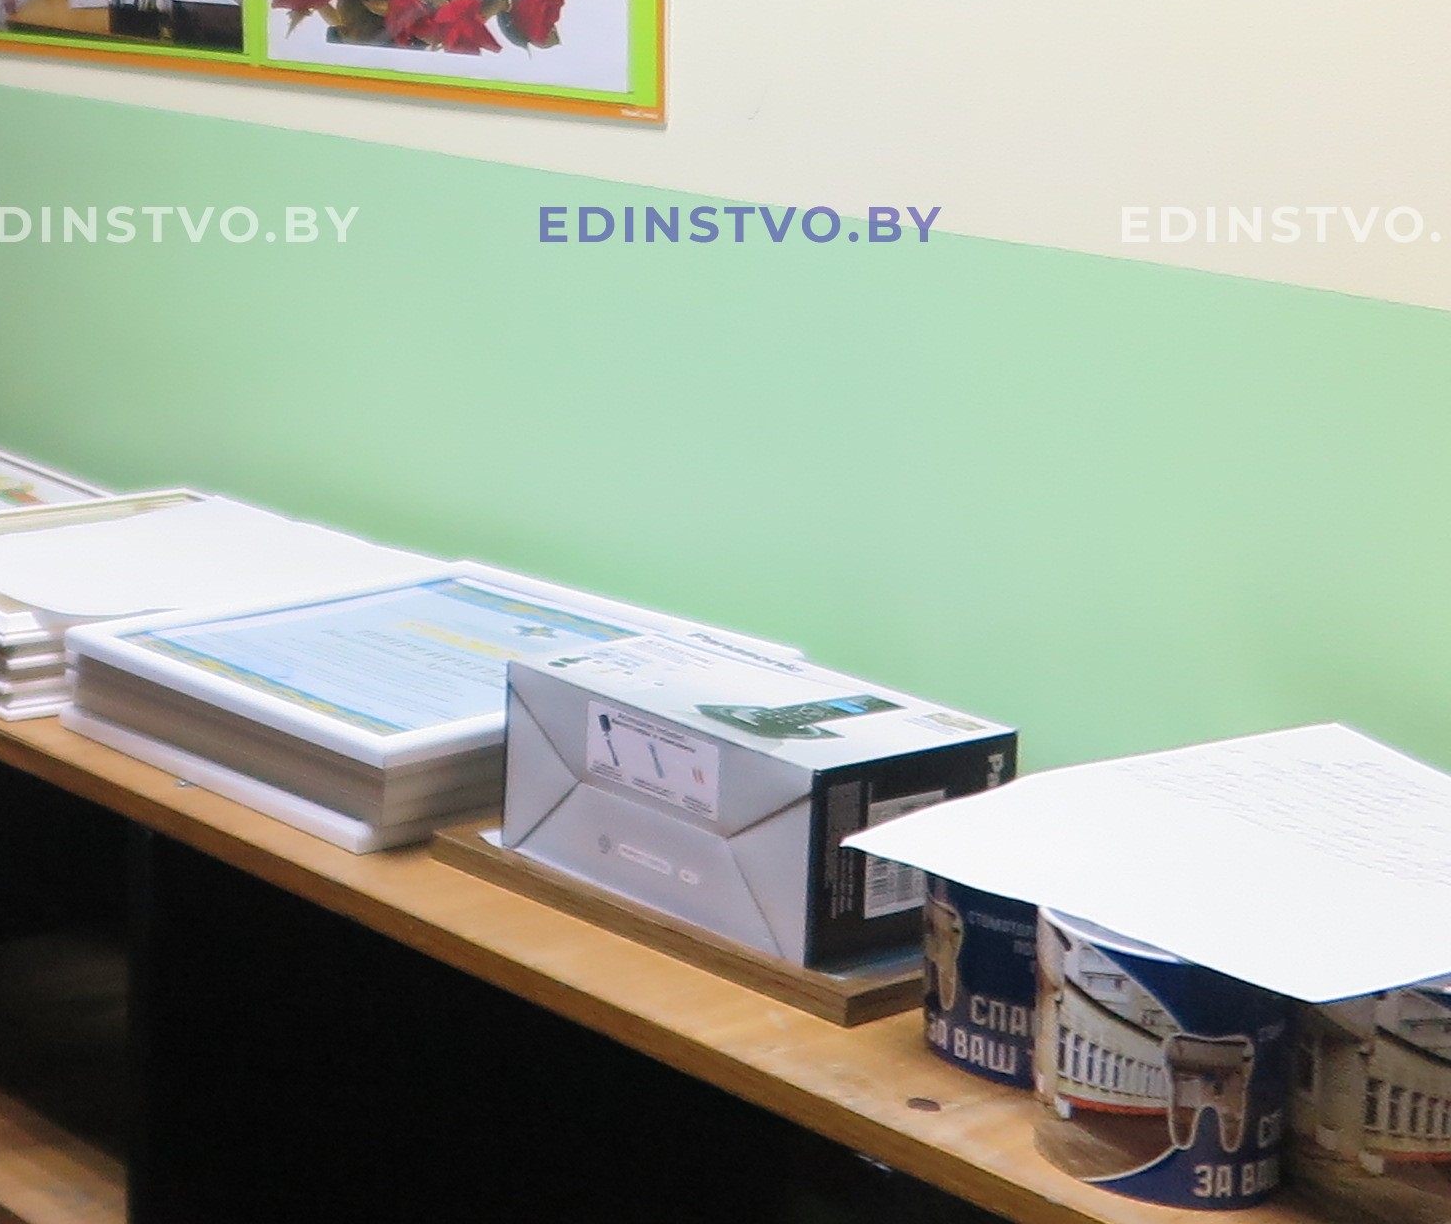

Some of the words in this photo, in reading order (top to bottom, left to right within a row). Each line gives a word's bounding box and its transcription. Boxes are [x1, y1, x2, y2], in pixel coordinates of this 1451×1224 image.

[970, 994, 1036, 1038] СПА
[953, 1027, 1018, 1075] ВАШ
[1193, 1164, 1232, 1198] ЗА
